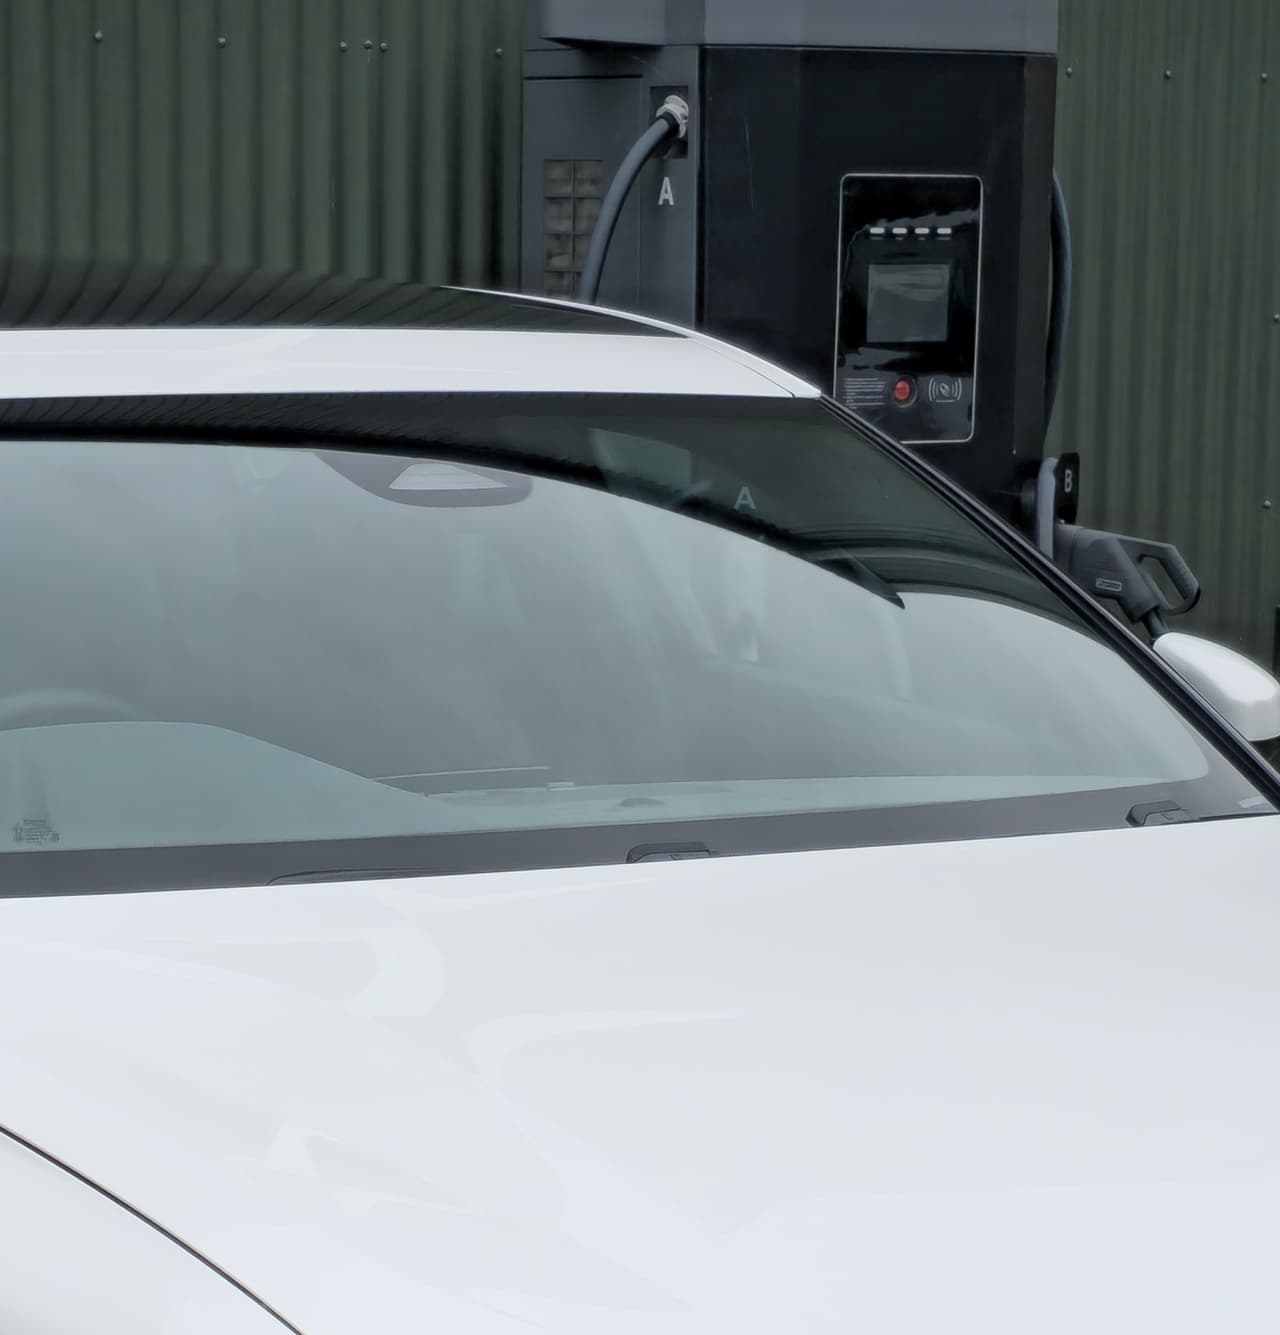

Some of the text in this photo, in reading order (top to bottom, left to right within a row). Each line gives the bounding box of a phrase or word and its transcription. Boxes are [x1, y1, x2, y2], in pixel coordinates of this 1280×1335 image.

[658, 176, 675, 206] A
[1064, 469, 1072, 493] B
[734, 485, 757, 511] A
